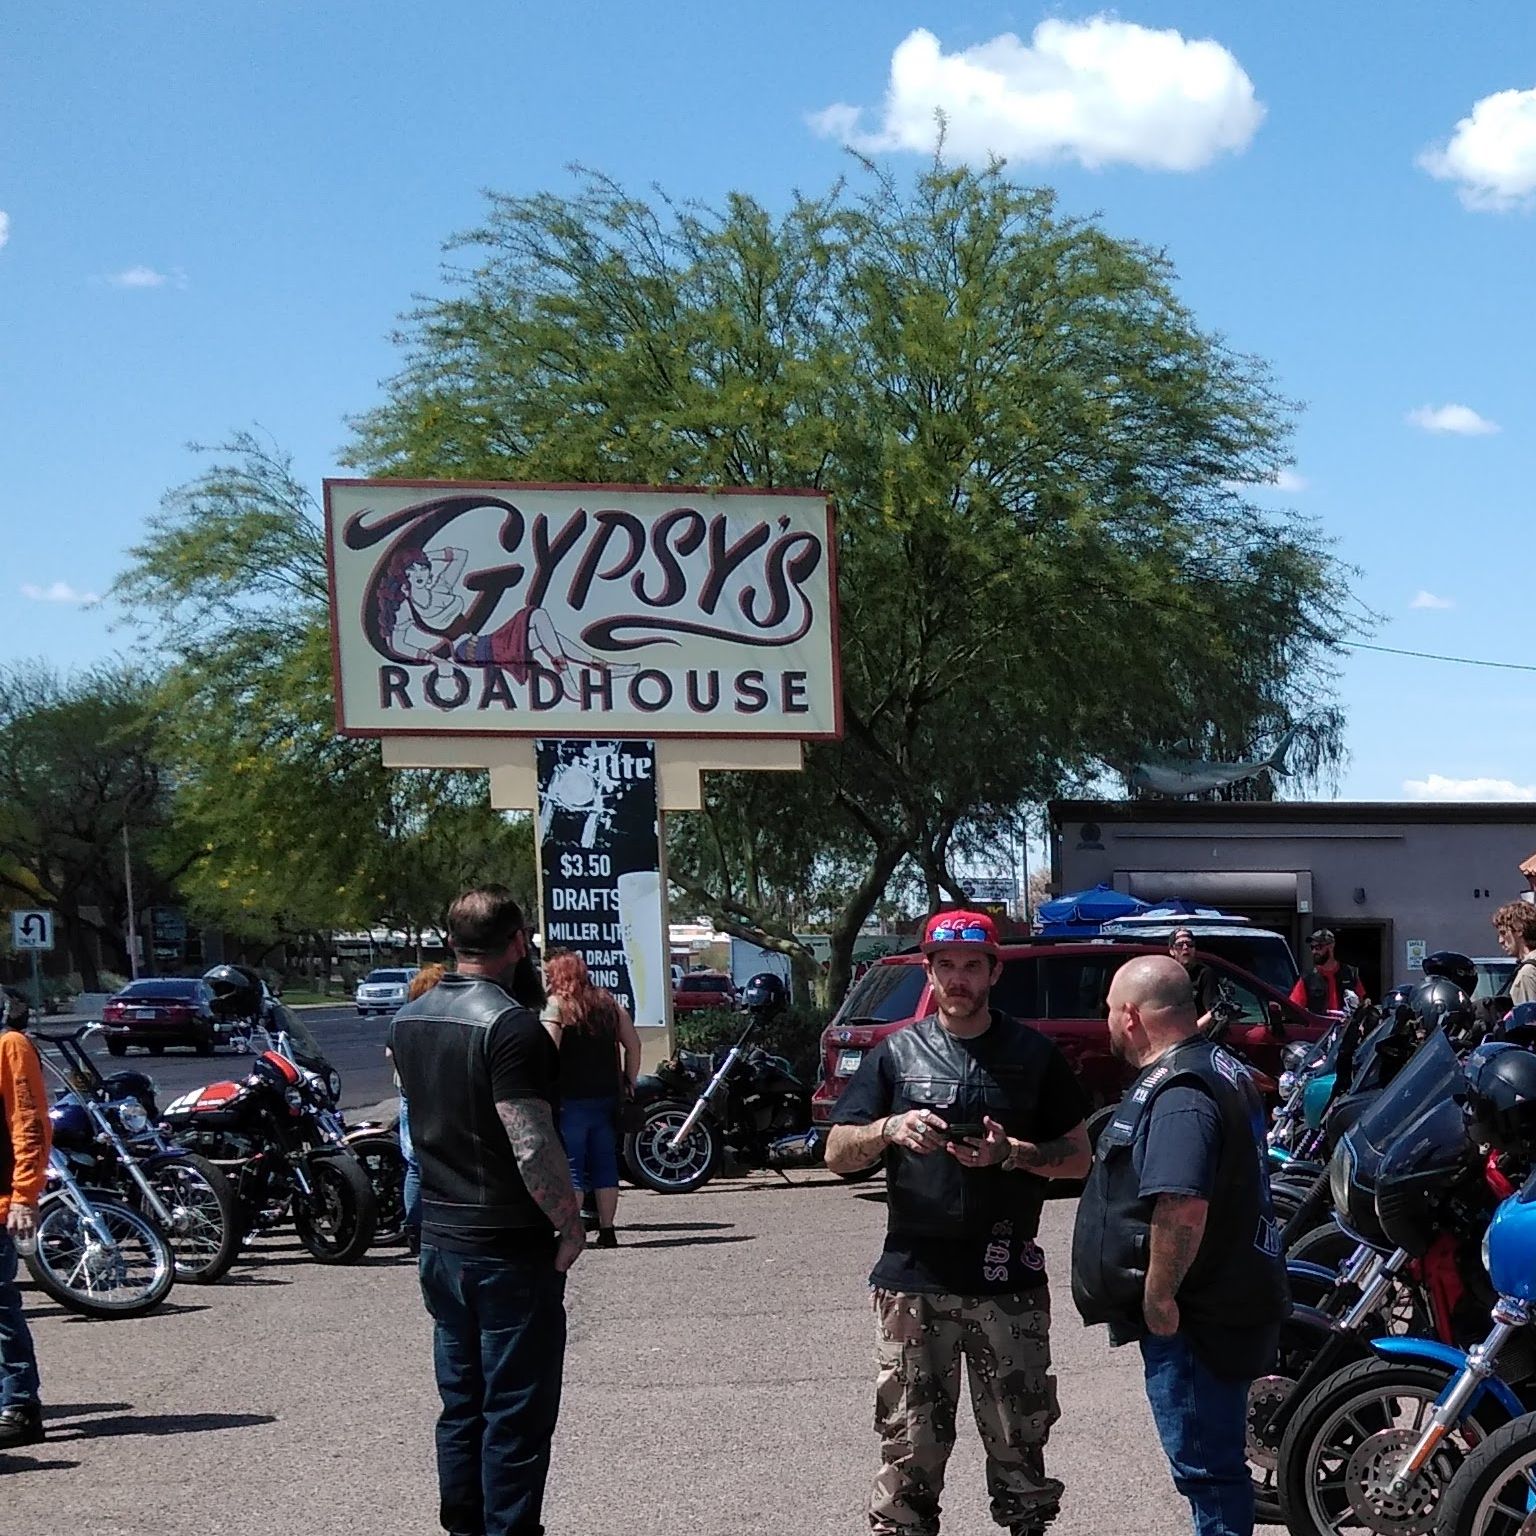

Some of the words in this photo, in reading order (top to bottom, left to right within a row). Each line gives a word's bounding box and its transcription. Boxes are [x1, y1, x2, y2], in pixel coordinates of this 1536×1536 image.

[342, 494, 822, 667] GYPSY'S
[378, 664, 810, 714] ROADHOUSE
[560, 851, 611, 879] $3.50
[552, 888, 621, 911] DRAFTS
[549, 923, 600, 941] MILLER
